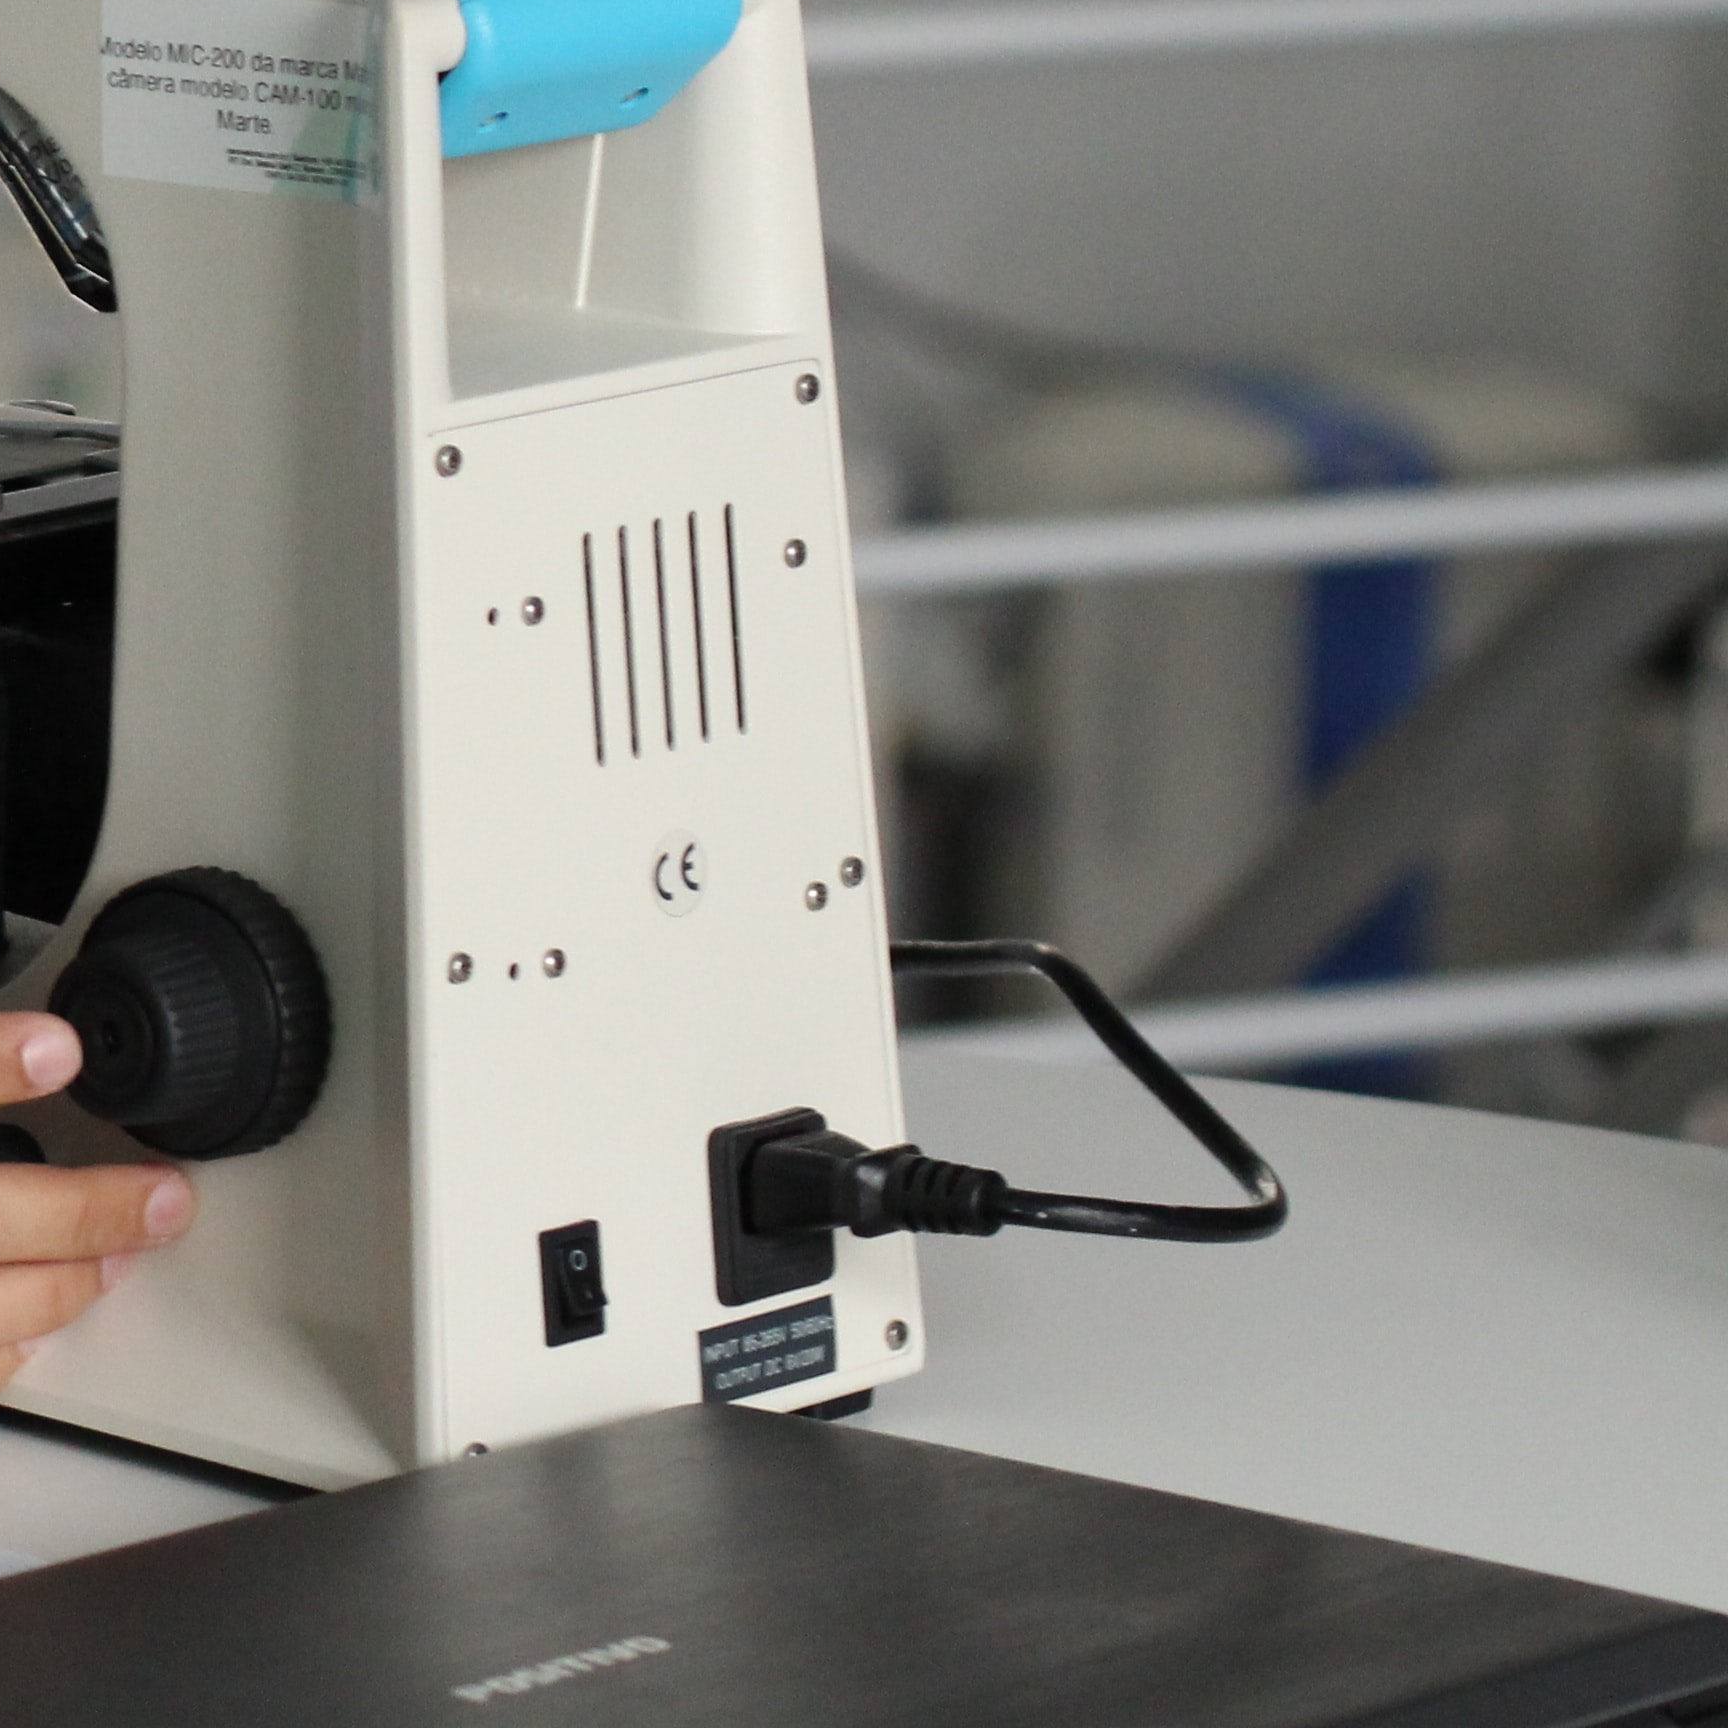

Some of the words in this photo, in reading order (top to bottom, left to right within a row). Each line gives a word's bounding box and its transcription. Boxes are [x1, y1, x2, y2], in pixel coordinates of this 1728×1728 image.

[167, 42, 245, 70] MIC-200
[251, 53, 274, 73] da
[280, 58, 339, 80] marca
[107, 67, 176, 94] câmera
[180, 77, 249, 101] modelo
[255, 81, 342, 110] CAM-100
[216, 109, 271, 134] Marte
